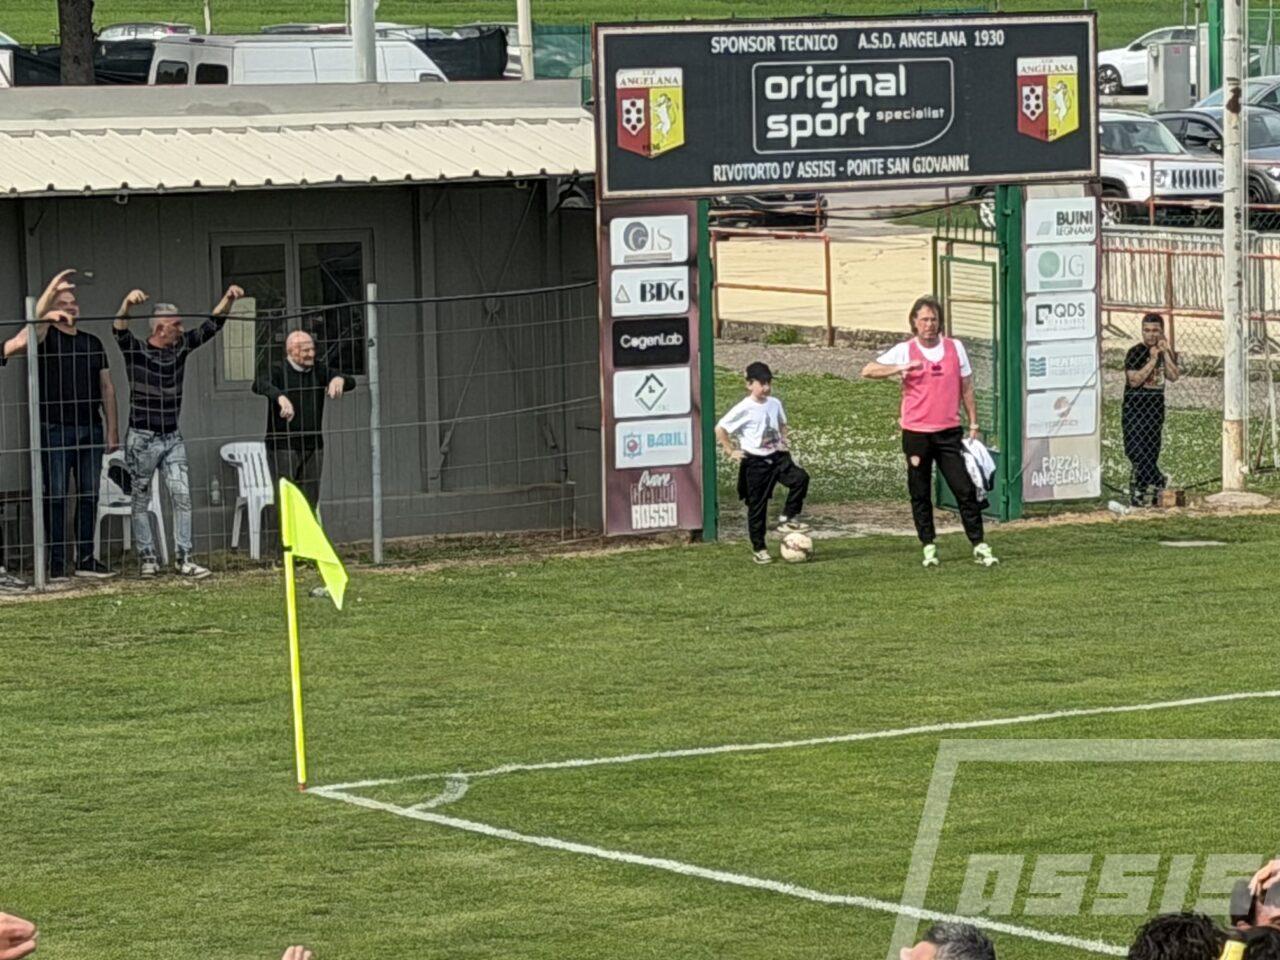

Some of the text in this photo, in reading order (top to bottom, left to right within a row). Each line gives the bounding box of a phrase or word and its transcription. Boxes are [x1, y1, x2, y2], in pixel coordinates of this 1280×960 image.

[711, 28, 1004, 54] SPONSOR TECNICO A.S.D. ANGELANA 1930
[764, 64, 906, 109] original
[766, 105, 944, 148] sport specialist
[713, 161, 780, 182] RIVOTORTO
[797, 159, 837, 179] ASSISI
[847, 157, 884, 177] PONTE
[887, 157, 910, 175] SAN
[912, 154, 970, 174] GIOVANNI
[1056, 210, 1093, 226] BUINI
[640, 281, 684, 303] BDG
[1054, 302, 1085, 319] QDS
[1042, 456, 1080, 473] FORZA
[1031, 469, 1092, 488] ANGELANA
[631, 502, 677, 530] ROSSO
